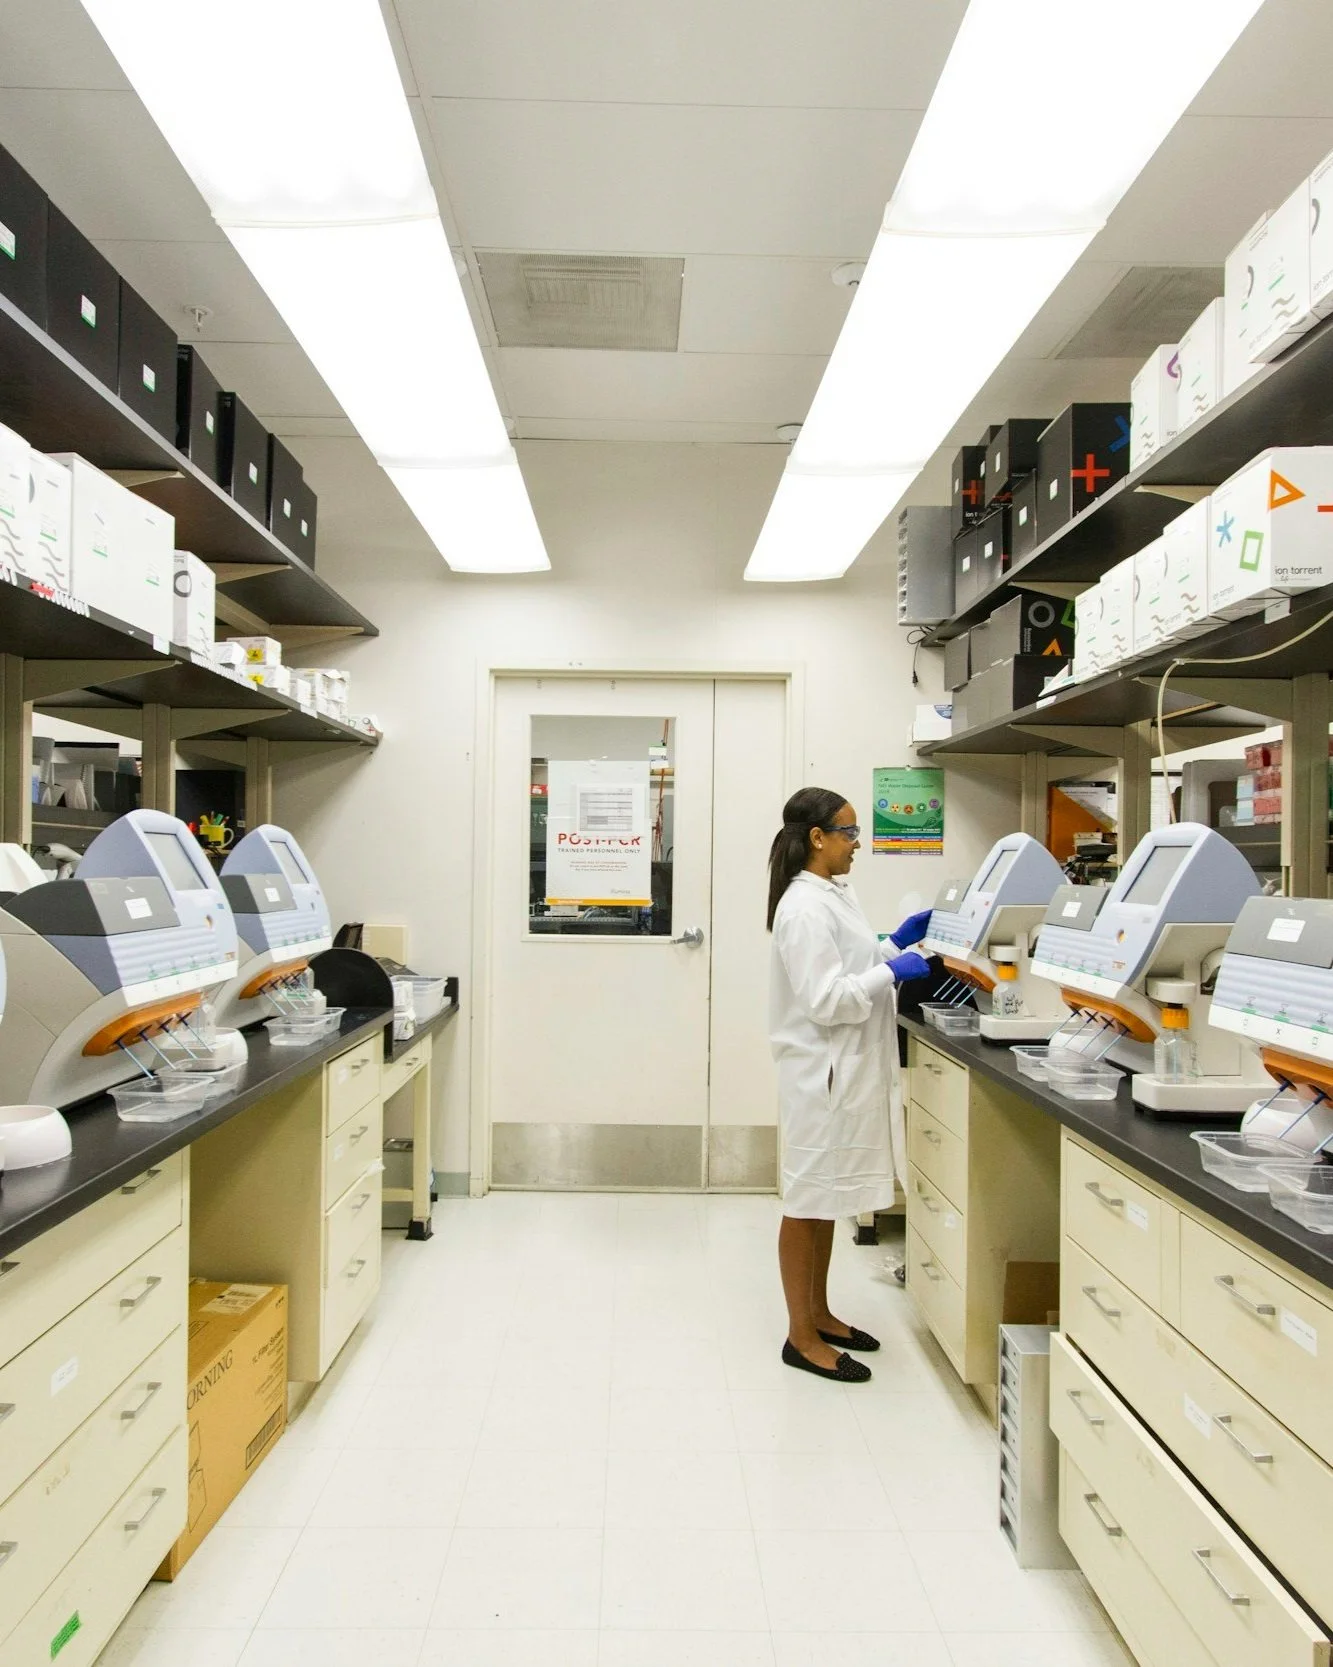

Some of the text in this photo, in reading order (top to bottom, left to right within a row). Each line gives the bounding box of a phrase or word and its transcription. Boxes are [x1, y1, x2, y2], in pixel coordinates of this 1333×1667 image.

[1275, 566, 1322, 575] ion torrent
[187, 1349, 233, 1410] ORNING
